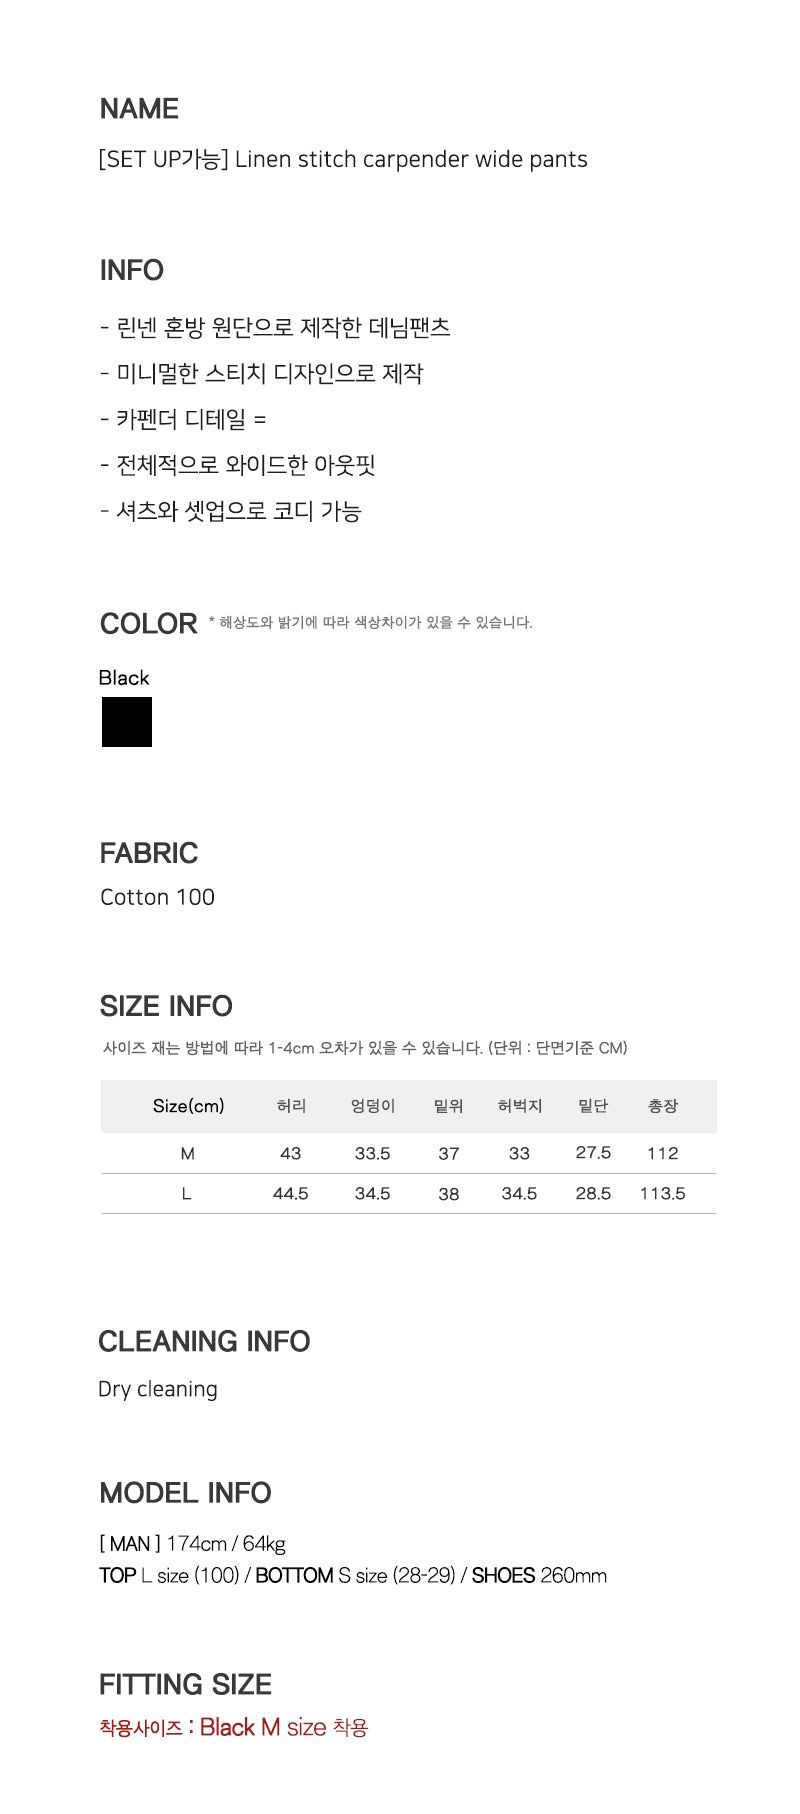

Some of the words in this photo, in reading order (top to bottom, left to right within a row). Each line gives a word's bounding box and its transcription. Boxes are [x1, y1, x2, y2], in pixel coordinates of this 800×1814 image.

[101, 97, 179, 119] NAME
[100, 149, 147, 171] [SET
[154, 148, 228, 171] UP가능]
[236, 150, 290, 167] Linen
[299, 149, 356, 167] stitch
[364, 149, 469, 172] carpender
[475, 149, 523, 167] wide
[531, 151, 587, 172] pants
[101, 258, 164, 281] INFO
[118, 317, 156, 339] 린넨
[164, 317, 205, 339] 혼방
[212, 317, 294, 339] 원단으로
[301, 317, 362, 339] 제작한
[370, 317, 450, 339] 데님팬츠
[118, 363, 199, 385] 미니멀한
[205, 363, 265, 385] 스티치
[275, 363, 376, 385] 디자인으로
[383, 363, 424, 385] 제작
[117, 409, 176, 431] 카펜더
[186, 409, 245, 431] 디테일
[117, 454, 219, 477] 전체적으로
[226, 454, 308, 476] 와이드한
[315, 454, 374, 476] 아웃핏
[117, 500, 179, 522] 셔츠와
[185, 500, 267, 522] 셋업으로
[273, 500, 312, 522] 코디
[322, 500, 362, 523] 가능
[101, 612, 198, 634] COLOR
[220, 616, 273, 629] 해상도와
[279, 616, 317, 629] 밝기에
[324, 616, 350, 629] 따라
[355, 616, 422, 629] 색상차이가
[427, 616, 452, 629] 있을
[457, 616, 471, 629] 수
[476, 616, 532, 629] 있습니다.
[99, 669, 149, 685] Black
[101, 842, 198, 864] FABRIC
[101, 888, 168, 905] Cotton
[178, 888, 214, 905] 100
[100, 994, 159, 1017] SIZE
[170, 994, 232, 1017] INFO
[153, 1097, 224, 1114] Size(cm)
[277, 1099, 305, 1113] 허리
[352, 1099, 394, 1113] 엉덩이
[435, 1099, 462, 1113] 밑위
[498, 1099, 541, 1113] 허벅지
[579, 1099, 608, 1113] 밑단
[648, 1099, 678, 1113] 총장
[181, 1147, 194, 1160] M
[280, 1147, 301, 1160] 43
[355, 1147, 390, 1160] 33.5
[439, 1147, 459, 1160] 37
[509, 1147, 530, 1160] 33
[576, 1146, 611, 1159] 27.5
[648, 1147, 678, 1160] 112
[183, 1187, 191, 1200] L
[273, 1187, 308, 1200] 44.5
[355, 1187, 390, 1200] 34.5
[439, 1188, 459, 1201] 38
[502, 1187, 537, 1200] 34.5
[576, 1187, 611, 1200] 28.5
[641, 1187, 685, 1200] 113.5
[99, 1330, 237, 1352] CLEANING
[248, 1330, 310, 1352] INFO
[99, 1380, 131, 1401] Dry
[138, 1380, 217, 1401] cleaning
[101, 1481, 199, 1504] MODEL
[209, 1481, 271, 1504] INFO
[111, 1536, 150, 1551] MAN
[168, 1535, 227, 1551] 174cm
[243, 1535, 286, 1555] 64kg
[99, 1567, 136, 1583] TOP
[142, 1567, 152, 1583] L
[158, 1567, 189, 1583] size
[195, 1565, 239, 1585] (100)
[256, 1567, 333, 1583] BOTTOM
[339, 1567, 351, 1583] S
[356, 1567, 387, 1583] size
[393, 1565, 455, 1585] (28-29)
[472, 1567, 535, 1583] SHOES
[541, 1567, 607, 1583] 260mm
[100, 1673, 202, 1695] FITTING
[213, 1673, 271, 1695] SIZE
[100, 1719, 183, 1737] 착용사이즈
[201, 1717, 255, 1736] Black
[262, 1717, 279, 1736] M
[288, 1717, 326, 1736] size
[333, 1718, 368, 1737] 착용
